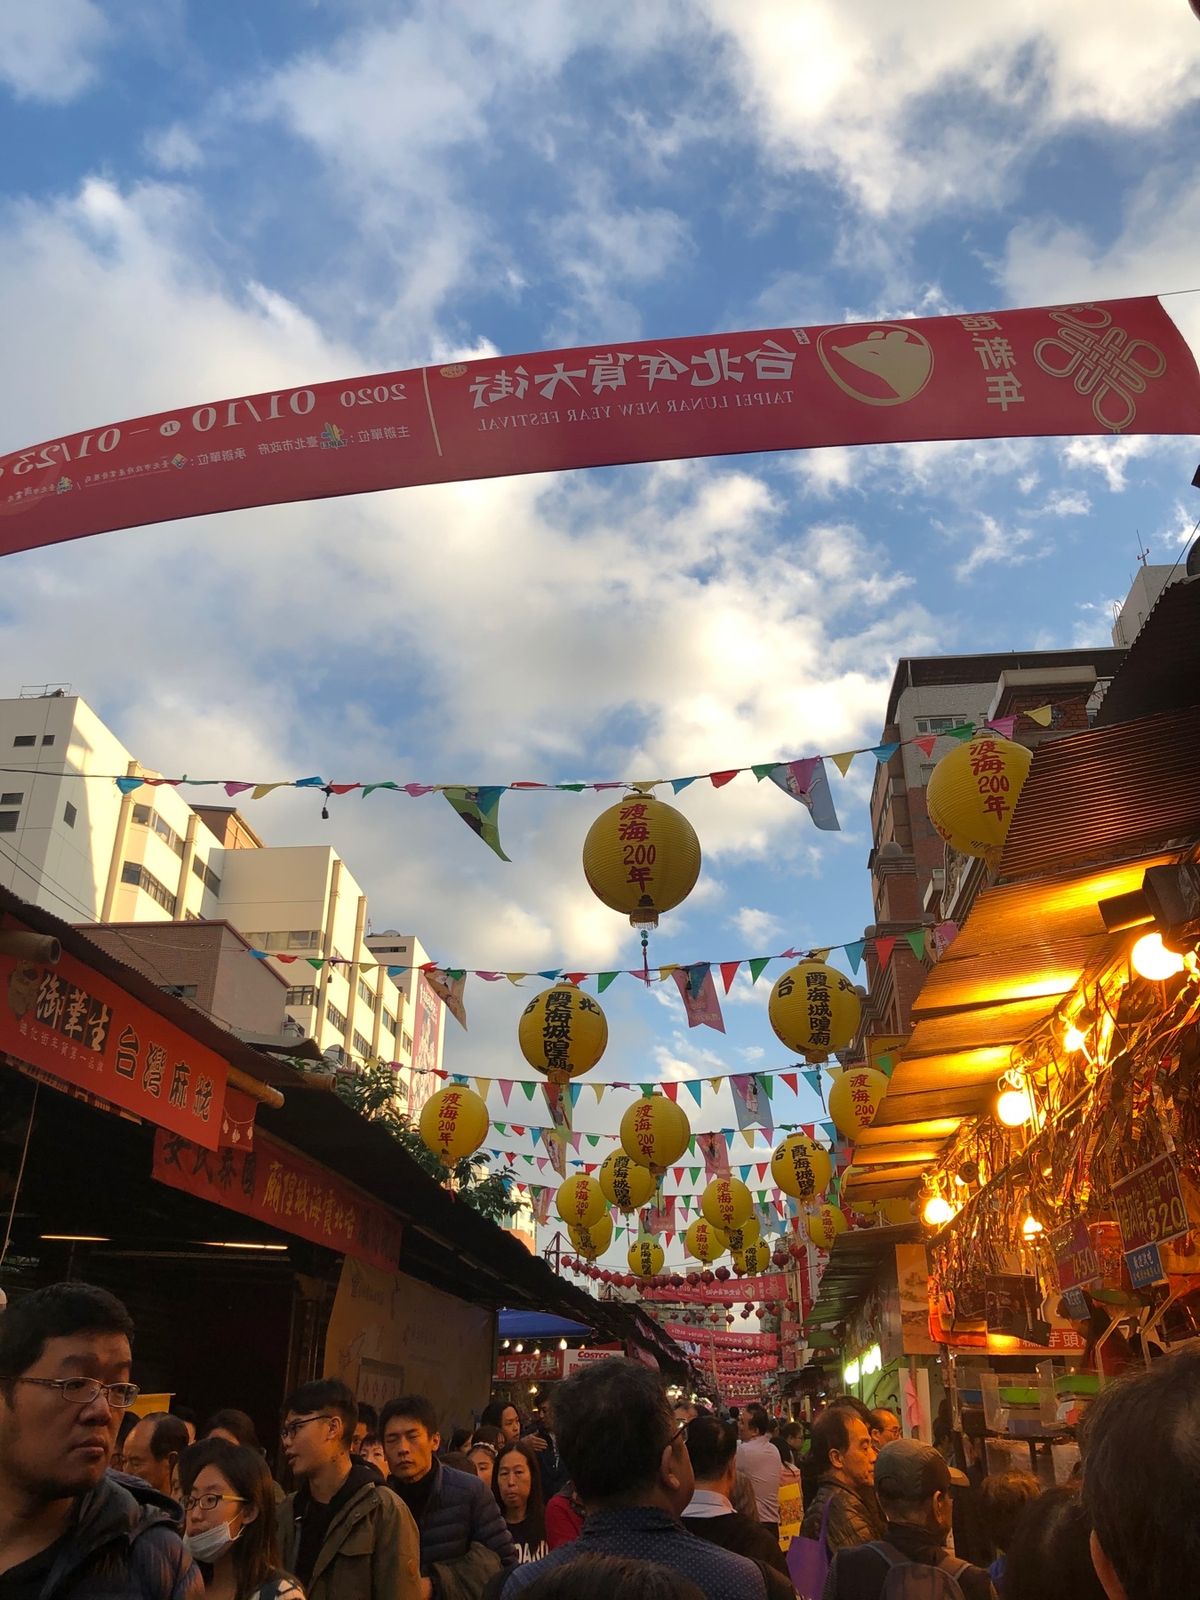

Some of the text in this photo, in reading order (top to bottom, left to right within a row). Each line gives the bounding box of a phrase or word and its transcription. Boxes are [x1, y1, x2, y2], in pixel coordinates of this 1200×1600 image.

[969, 740, 1010, 823] 渡海200年
[617, 803, 657, 893] 渡海200年
[806, 971, 833, 1046] 霞海城隍廟
[438, 1092, 464, 1147] 渡海200年
[634, 1104, 655, 1159] 渡海200年
[716, 1181, 735, 1225] 渡海200年
